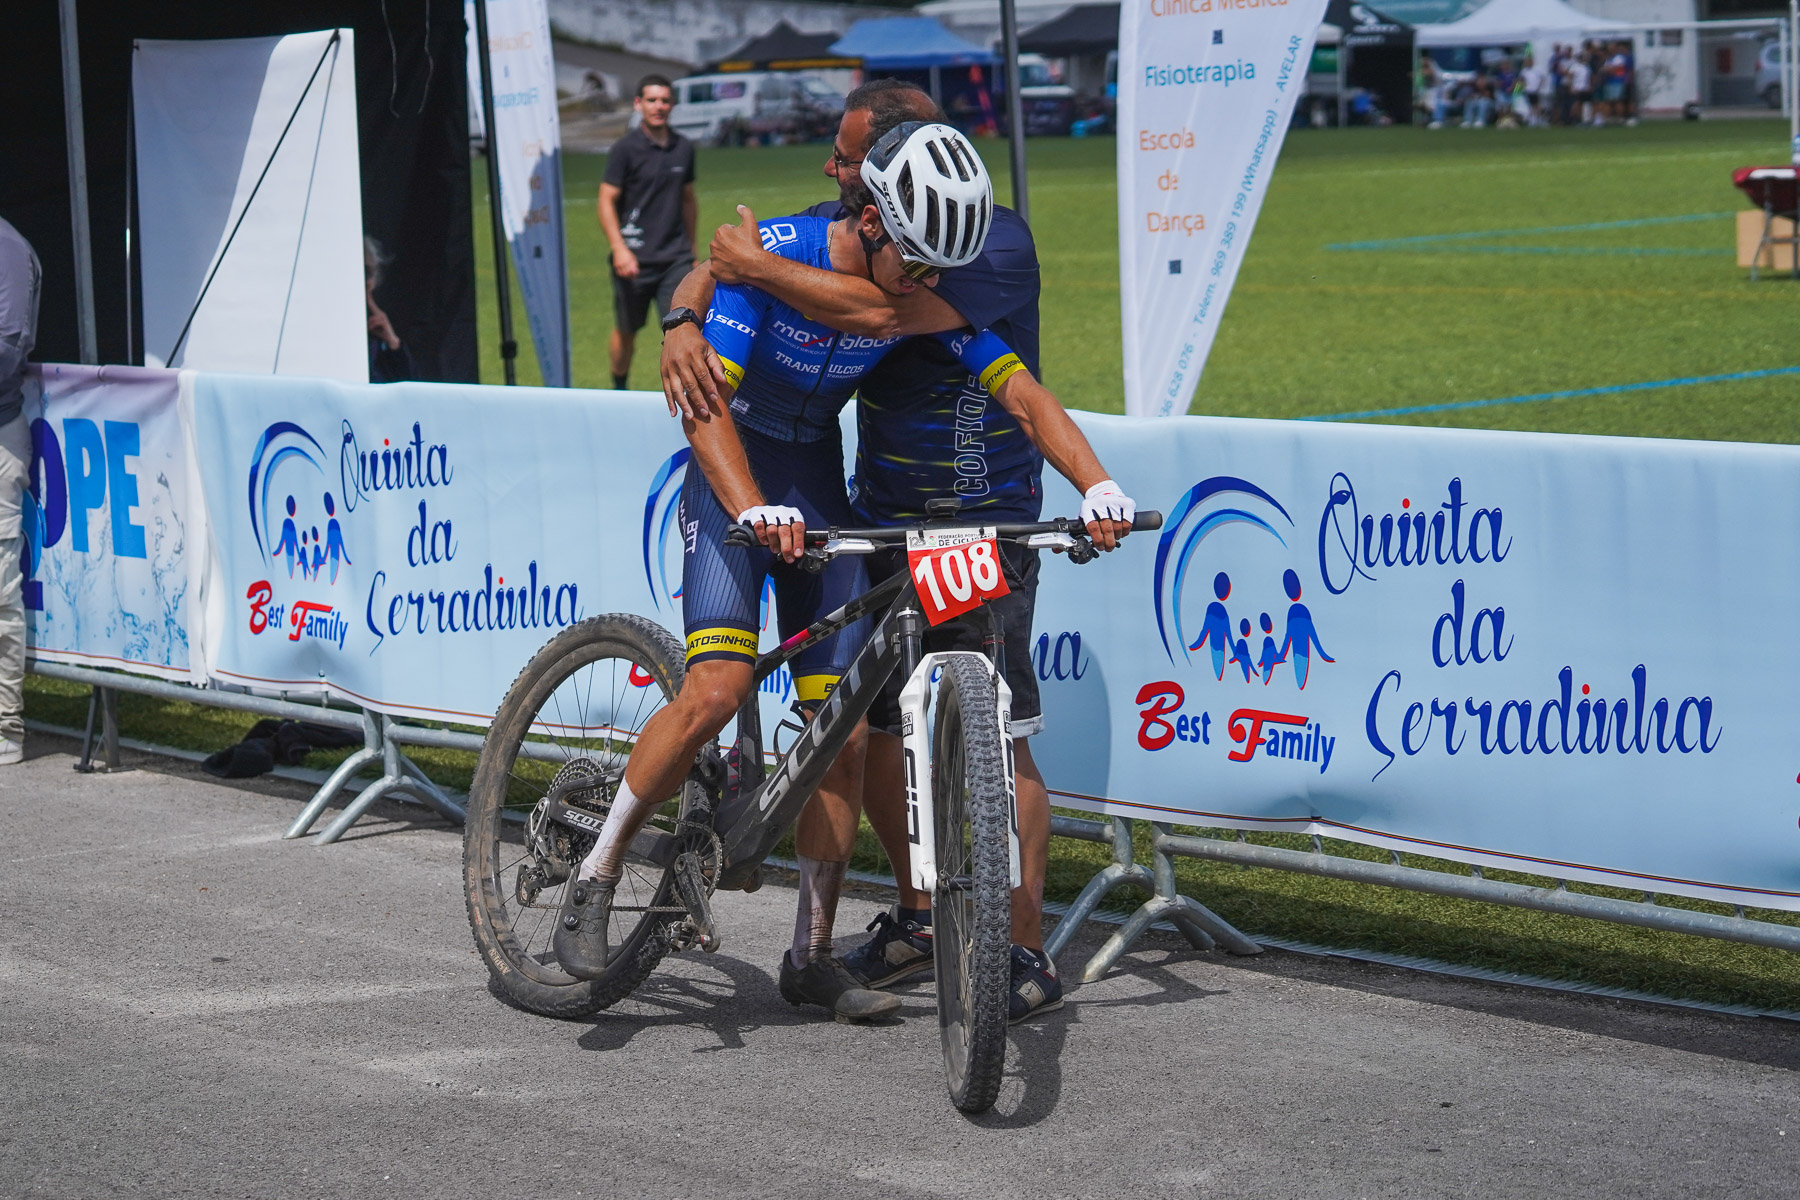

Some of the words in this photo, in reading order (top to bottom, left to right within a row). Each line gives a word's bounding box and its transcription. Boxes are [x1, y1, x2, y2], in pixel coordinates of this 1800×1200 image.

[1145, 59, 1256, 87] Fisioterapia
[1139, 126, 1195, 151] Escola
[881, 181, 906, 230] SCOTT
[1157, 169, 1179, 192] de
[1178, 343, 1194, 369] 076
[1211, 250, 1226, 277] 969
[1221, 222, 1237, 248] 389
[1231, 192, 1247, 218] 199
[1241, 109, 1278, 192] (Whatsapp)
[1276, 34, 1303, 92] AVELAR
[1147, 212, 1205, 236] Dança
[775, 351, 821, 374] TRANS
[828, 363, 865, 375] ULCOS
[341, 419, 454, 513] Quinta
[407, 499, 459, 568] da
[685, 519, 699, 553] BTT
[1318, 472, 1513, 595] Quinta
[366, 560, 584, 657] Serradinha
[914, 541, 999, 612] 108
[246, 580, 285, 635] Best
[288, 600, 349, 651] Family
[1432, 578, 1514, 668] da
[760, 609, 892, 822] SCOTT
[1135, 681, 1211, 752] Best
[1227, 708, 1336, 775] Family
[1365, 664, 1722, 782] Serradinha
